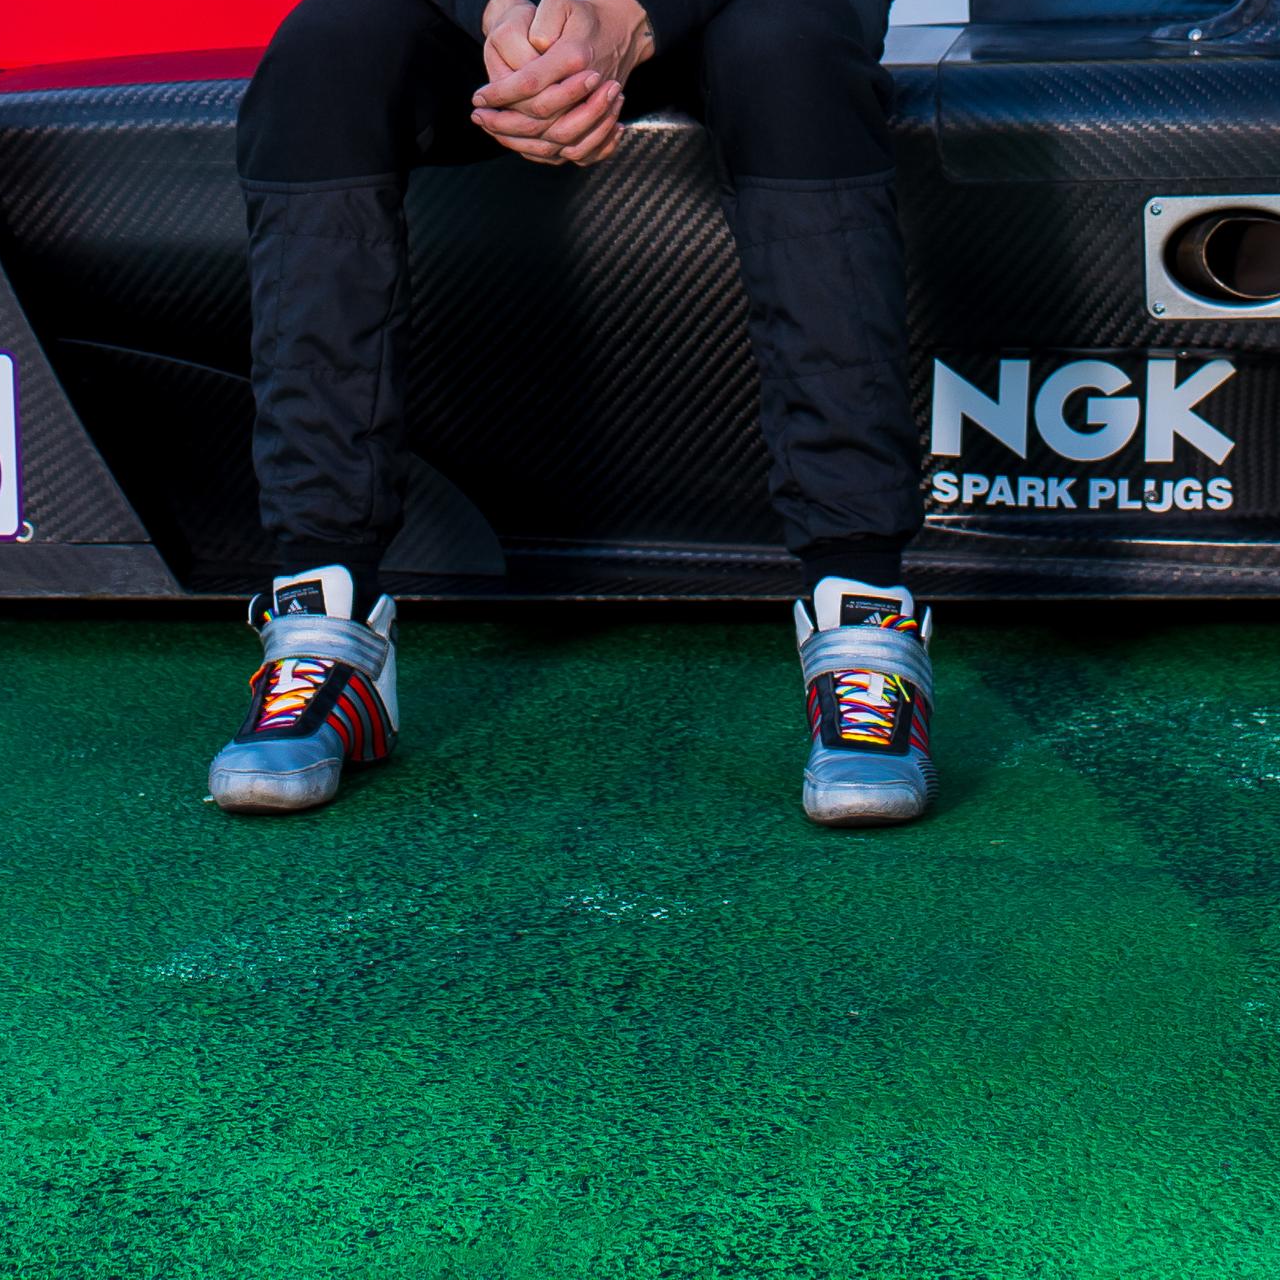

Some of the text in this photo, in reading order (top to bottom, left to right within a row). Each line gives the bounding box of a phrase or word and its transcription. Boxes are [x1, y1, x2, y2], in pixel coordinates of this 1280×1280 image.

[931, 357, 1237, 466] NGK
[931, 471, 1234, 513] SPARK PLUGS
